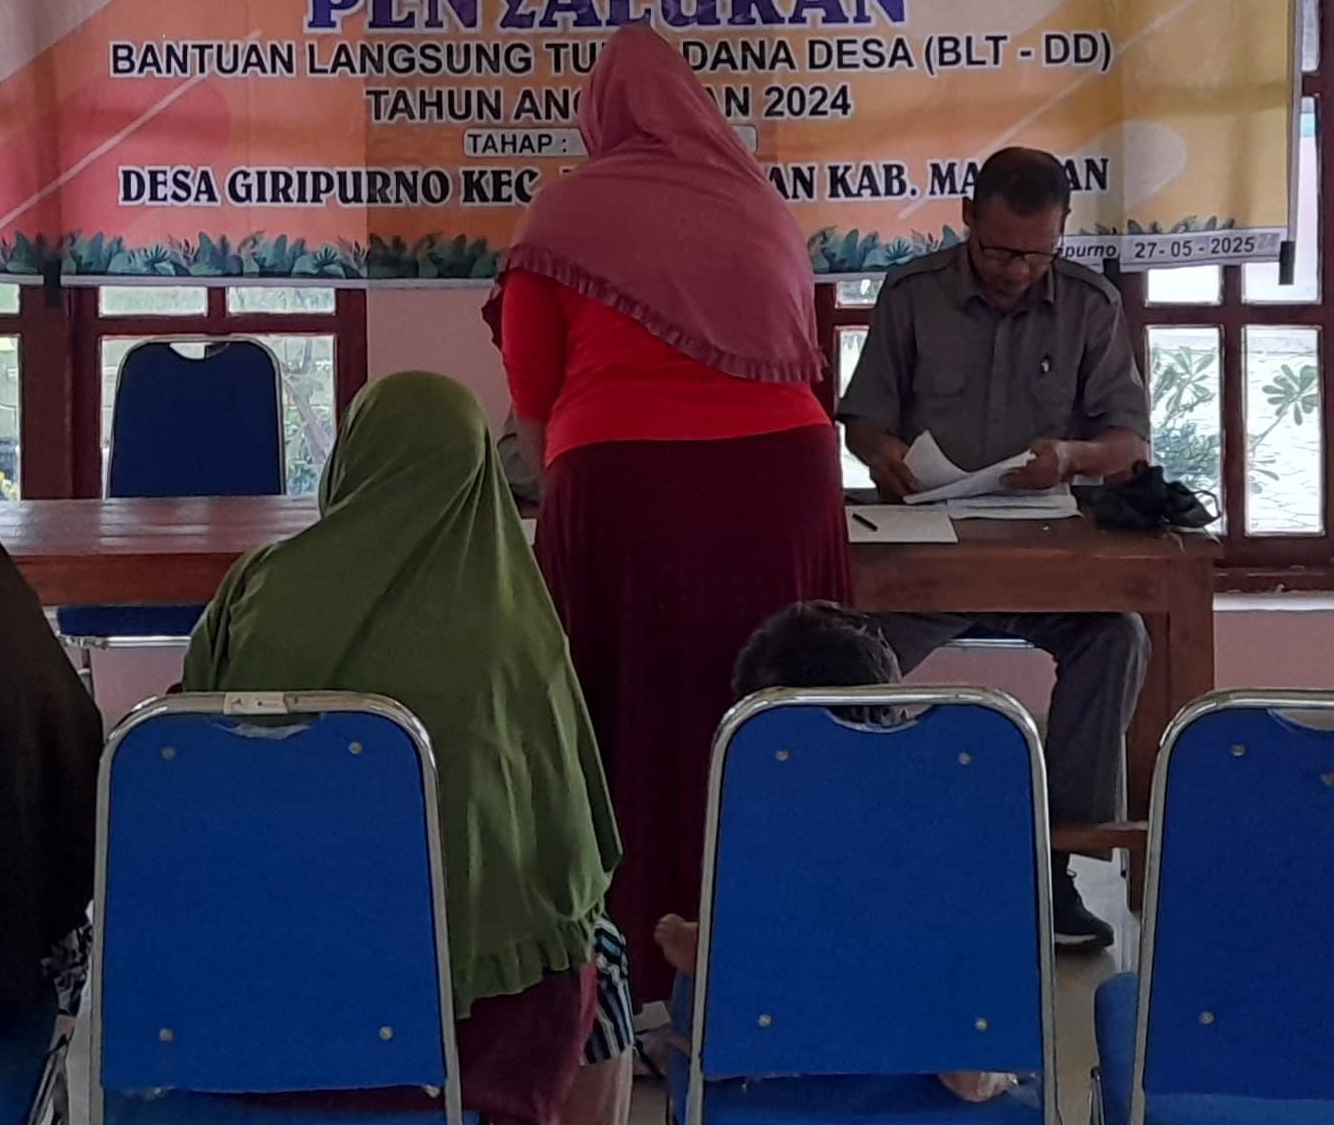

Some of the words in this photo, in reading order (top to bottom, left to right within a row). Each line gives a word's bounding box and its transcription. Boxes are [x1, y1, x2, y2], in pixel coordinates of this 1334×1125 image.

[112, 42, 295, 75] BANTUAN
[308, 42, 532, 75] LANGSUNG
[682, 40, 796, 71] DANA
[808, 38, 914, 69] DESA
[925, 35, 1008, 75] (BLT
[1045, 33, 1112, 71] DD)
[366, 88, 502, 122] TAHUN
[764, 85, 852, 118] 2024
[467, 133, 553, 154] TAHAP
[122, 169, 218, 203] DESA
[228, 169, 449, 203] GIRIPURNO
[827, 161, 917, 198] KAB.
[1171, 241, 1192, 257] 05
[1211, 236, 1255, 254] 2025
